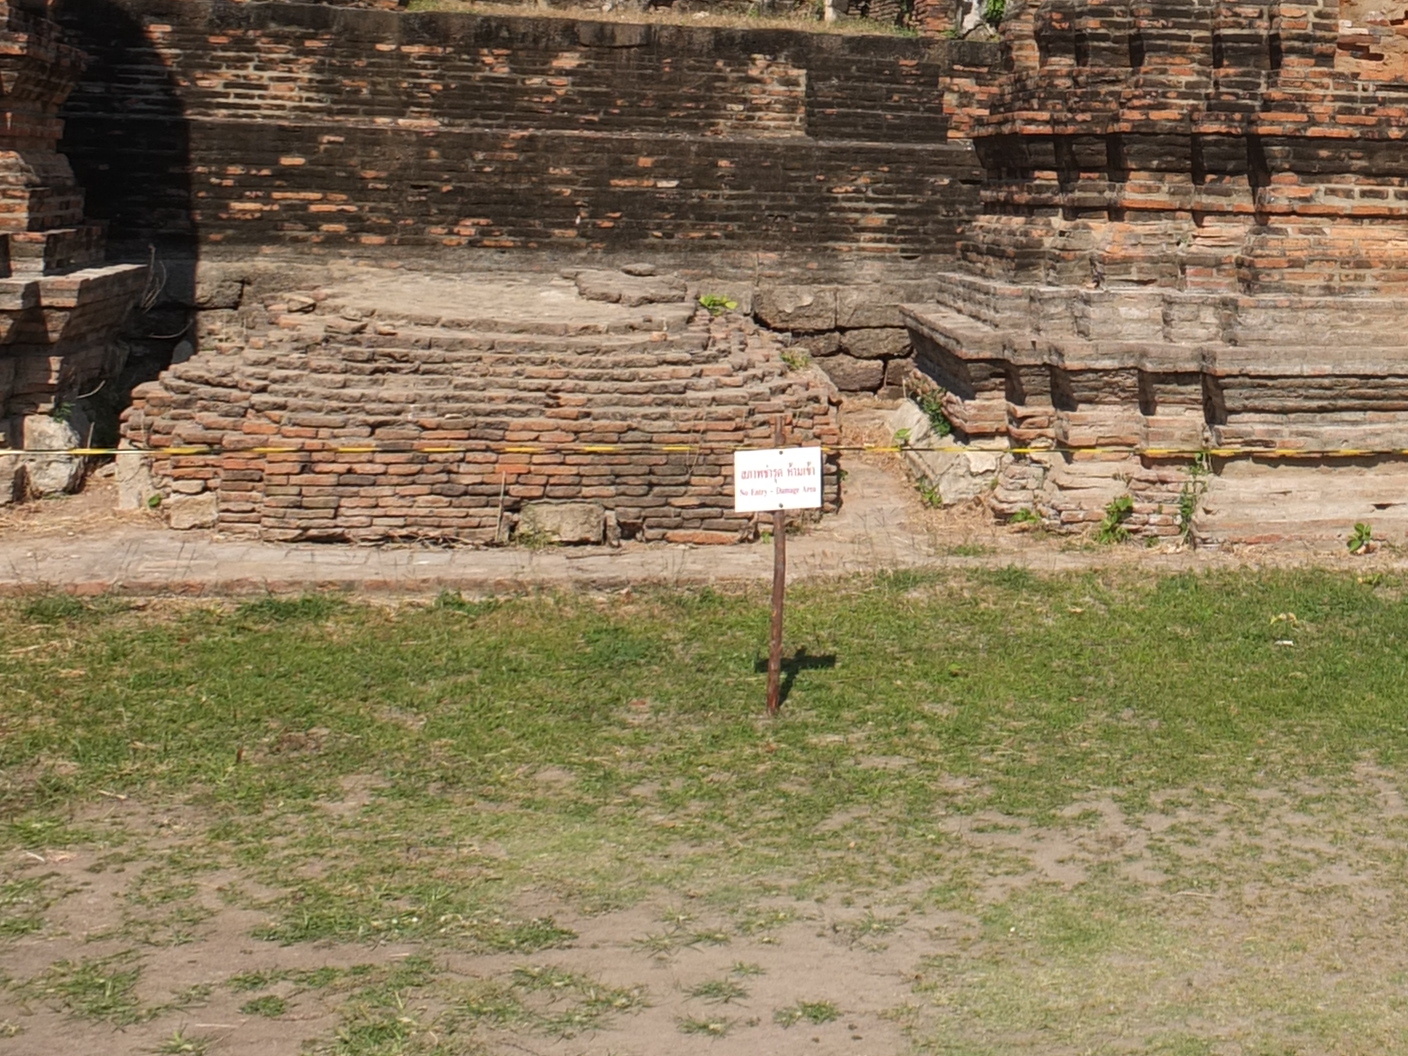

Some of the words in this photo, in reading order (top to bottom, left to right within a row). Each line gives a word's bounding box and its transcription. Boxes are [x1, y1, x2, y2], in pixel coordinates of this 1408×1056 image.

[787, 461, 815, 477] ห้ามเข้า
[751, 488, 767, 497] Entry
[776, 486, 800, 495] Damage
[803, 485, 816, 493] Area
